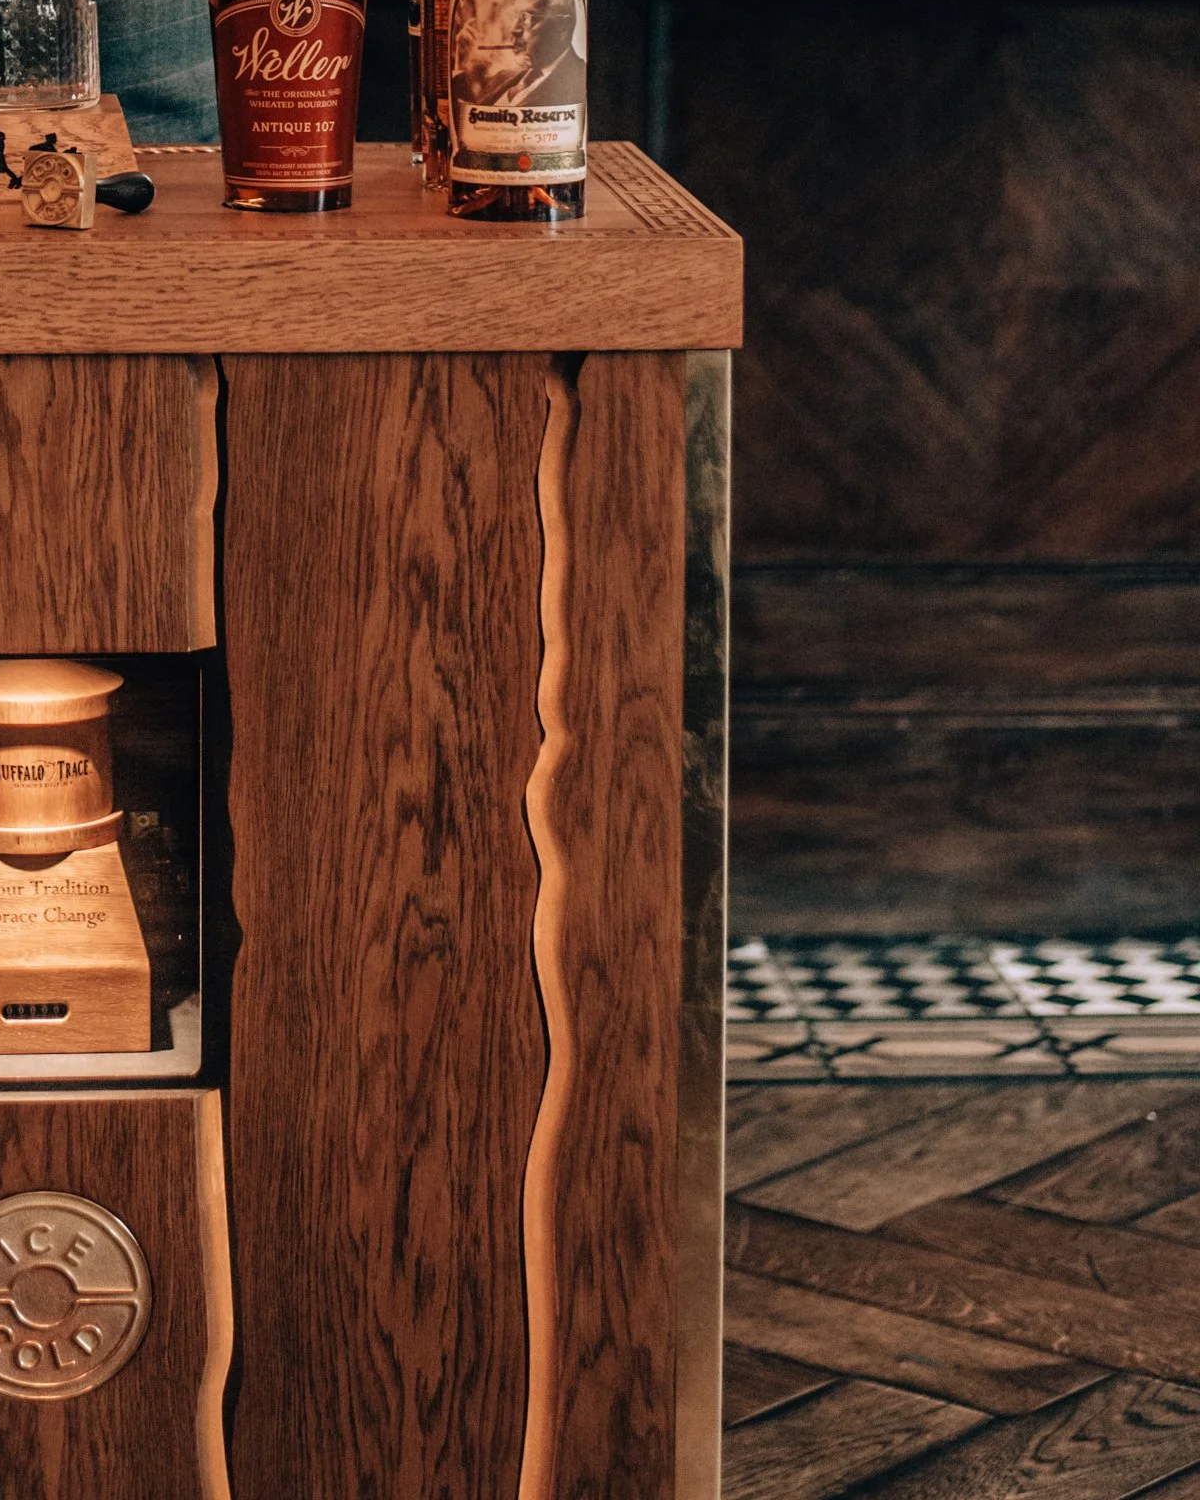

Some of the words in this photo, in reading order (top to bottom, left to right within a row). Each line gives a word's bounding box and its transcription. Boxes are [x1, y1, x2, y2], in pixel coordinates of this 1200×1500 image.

[232, 27, 352, 81] Weller
[261, 90, 280, 98] THE
[283, 90, 327, 98] ORIGINAL
[249, 100, 294, 109] WHEATED
[298, 99, 338, 109] BOURBON
[468, 107, 518, 126] Family
[520, 108, 575, 123] Reserve
[252, 121, 311, 135] ANTIQUE
[316, 121, 335, 133] 107
[57, 759, 89, 780] TRACE
[29, 879, 110, 896] Tradition
[43, 906, 106, 929] Change
